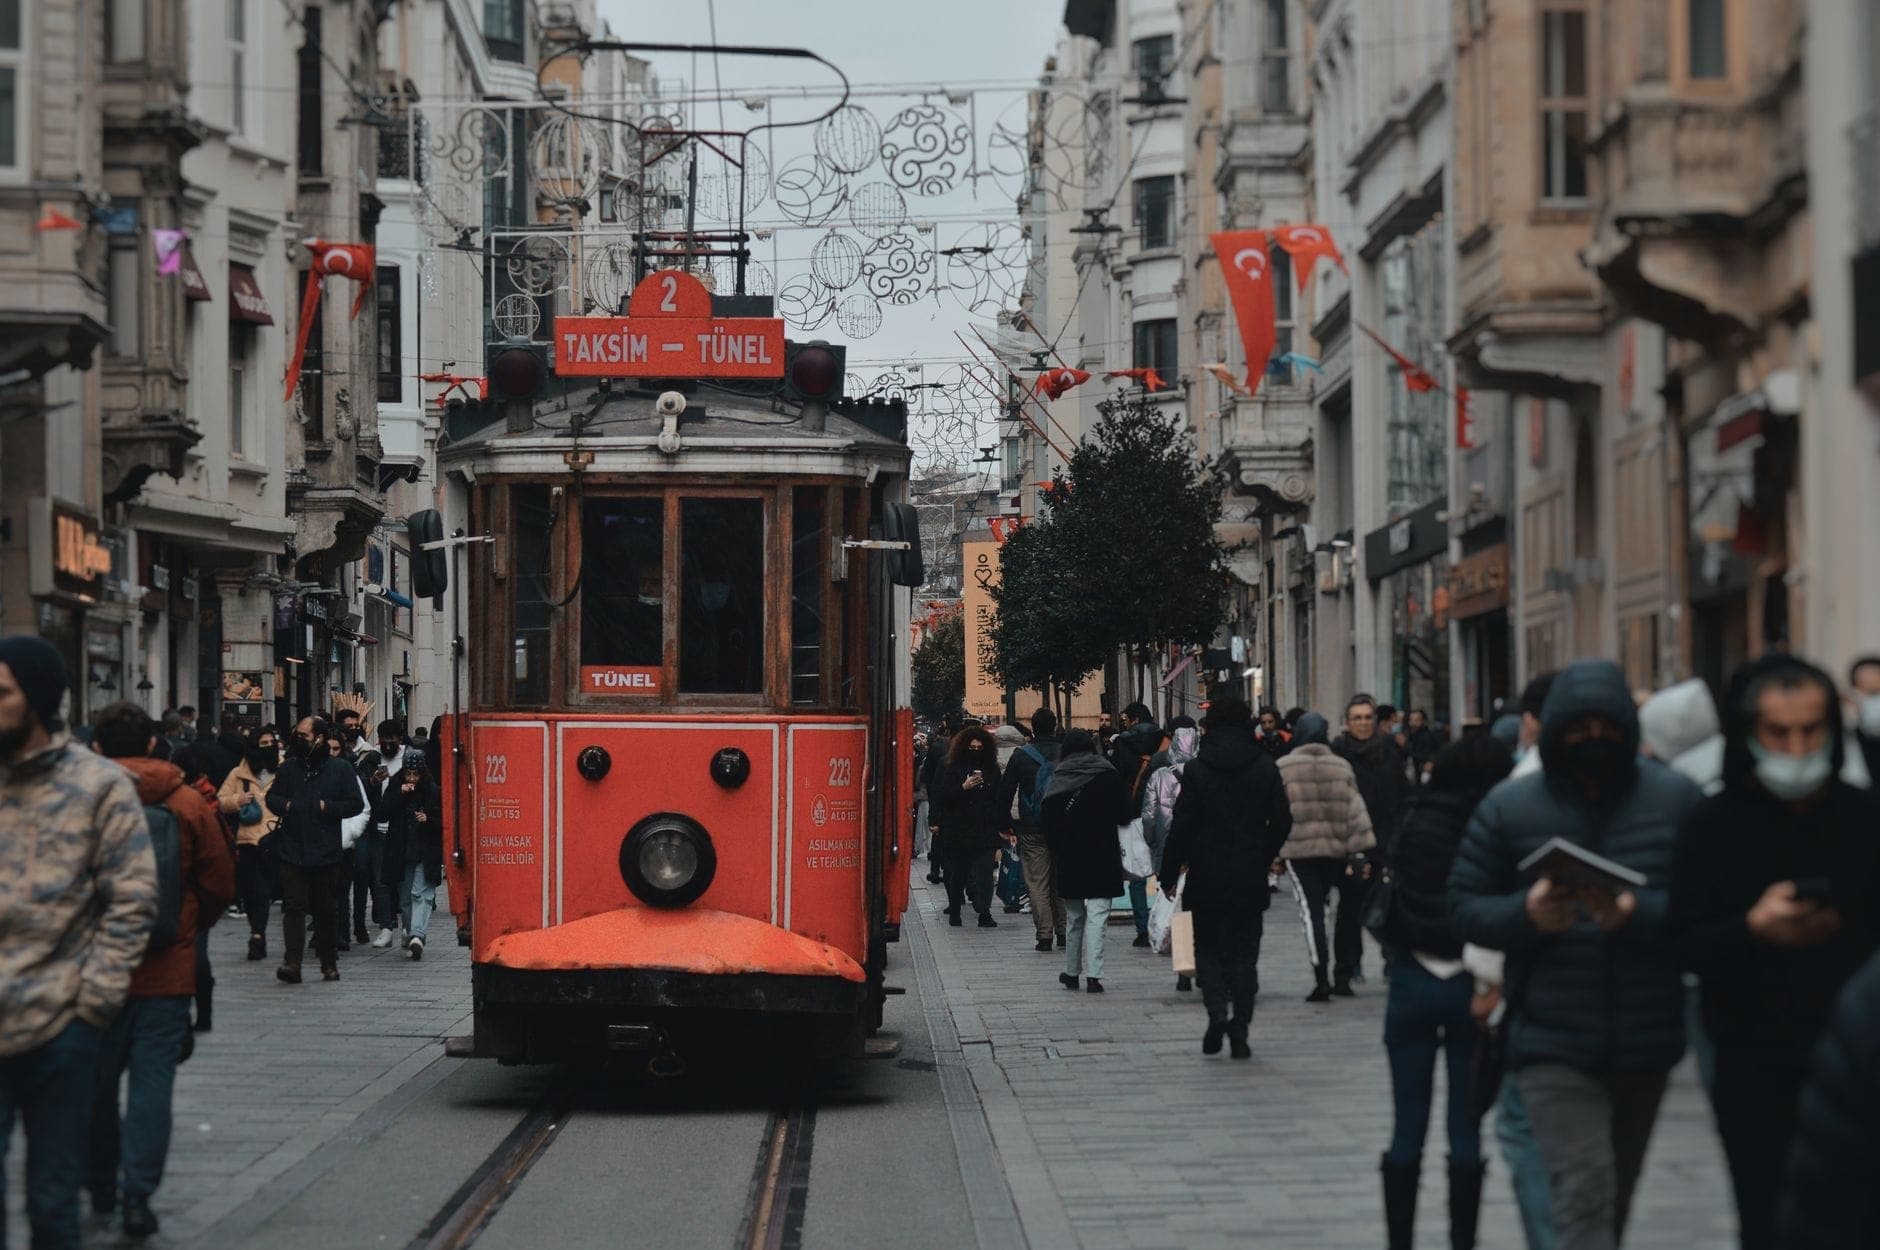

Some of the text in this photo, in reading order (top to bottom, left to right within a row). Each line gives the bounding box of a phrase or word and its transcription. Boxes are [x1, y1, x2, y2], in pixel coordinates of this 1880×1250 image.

[660, 276, 677, 312] 2
[564, 326, 648, 363] TAKSİM
[697, 327, 772, 364] TÜNEL
[591, 670, 656, 687] TÜNEL
[485, 754, 507, 784] 223
[828, 757, 851, 786] 223
[488, 809, 520, 819] ALO 153
[831, 811, 846, 821] ALO
[504, 835, 532, 848] YASAK
[808, 839, 844, 850] ASILMAK
[806, 856, 818, 868] VE
